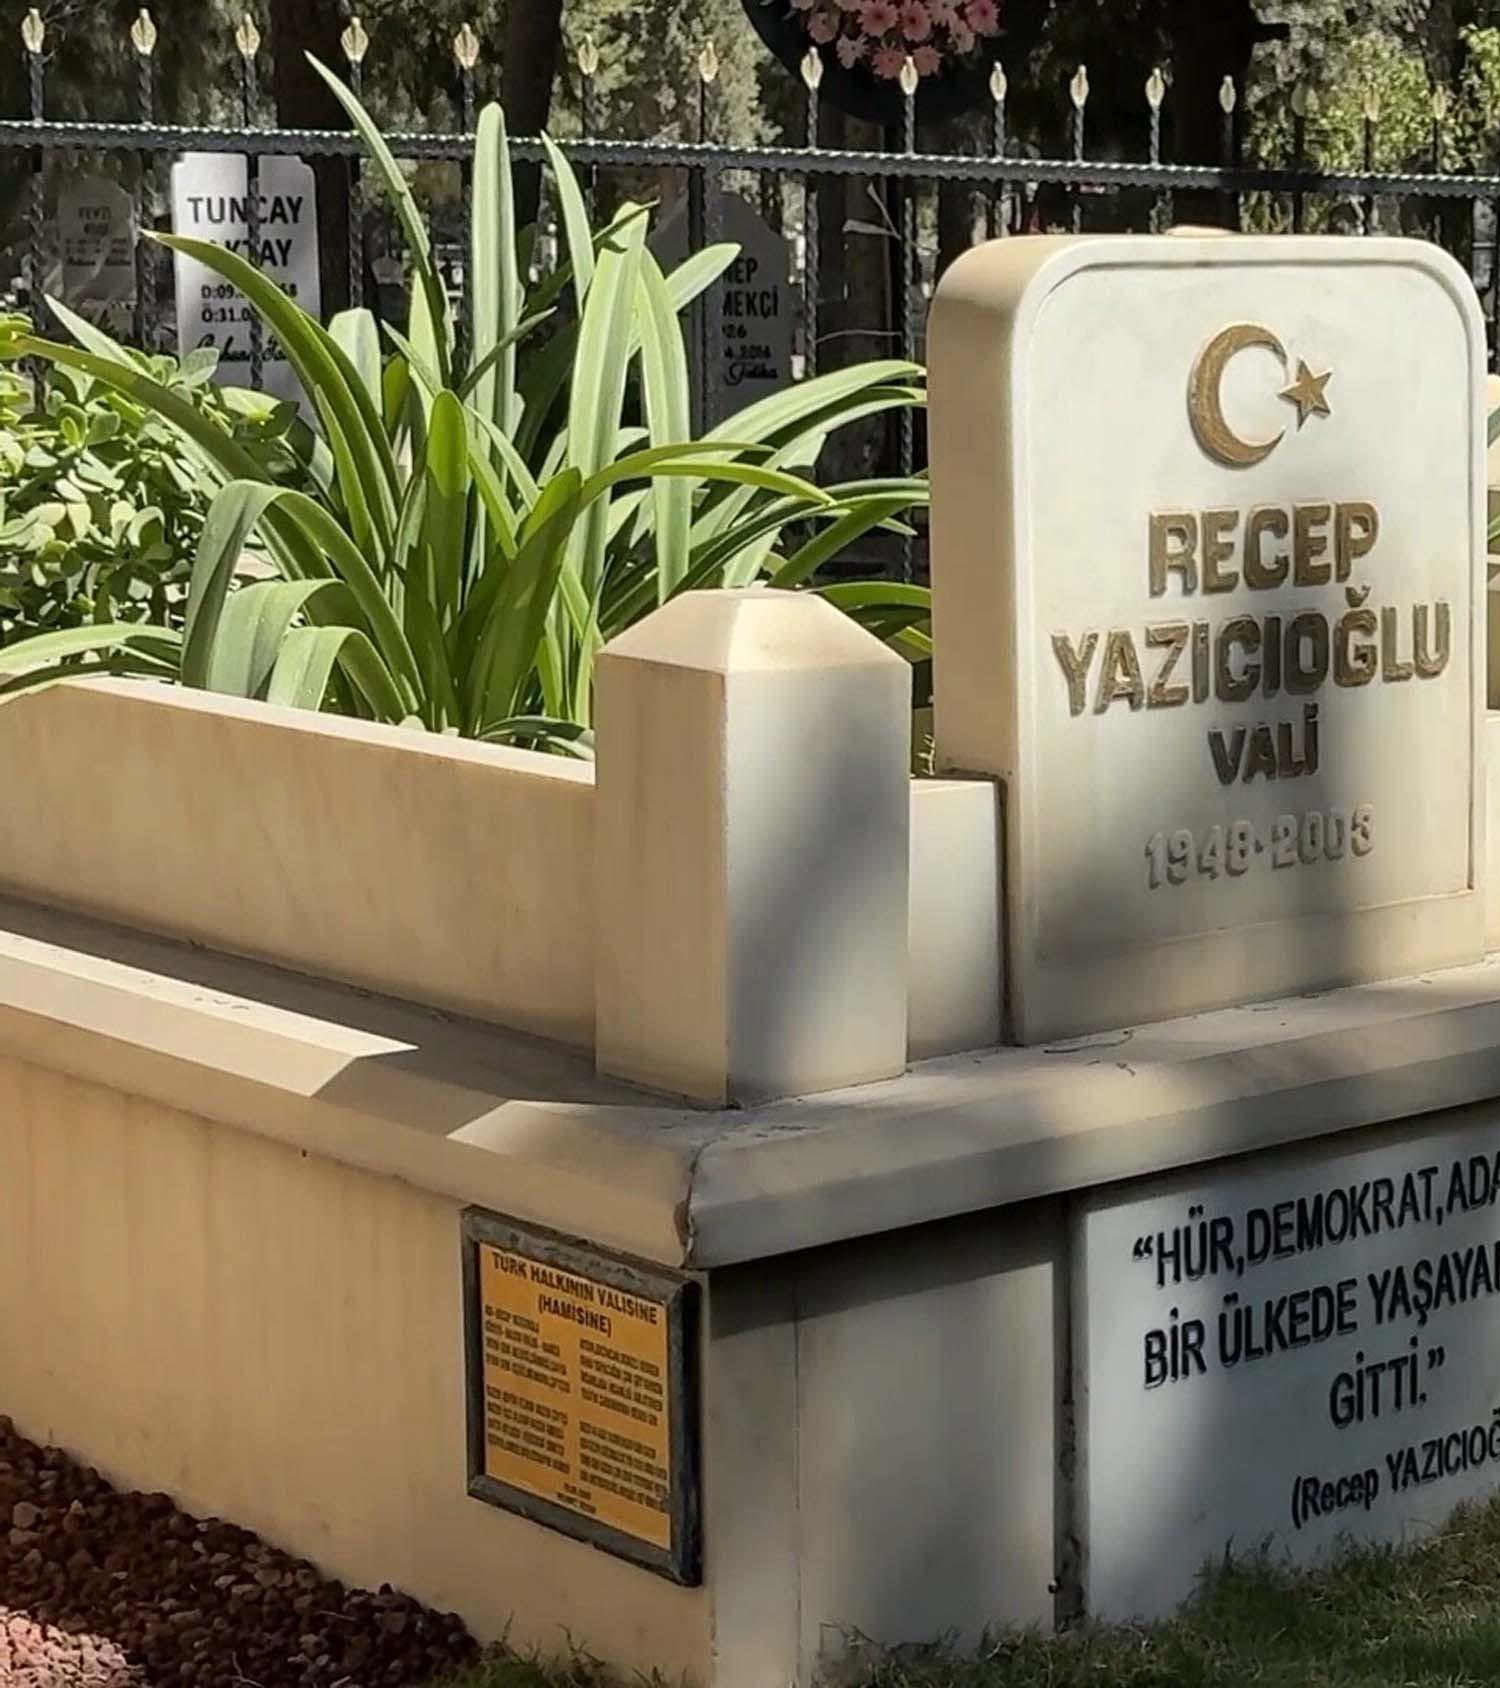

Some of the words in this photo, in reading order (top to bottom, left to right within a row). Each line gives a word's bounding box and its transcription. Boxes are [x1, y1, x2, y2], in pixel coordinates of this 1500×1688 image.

[1148, 500, 1380, 598] RECEP
[1050, 585, 1451, 717] YAZICIOĞLU
[1208, 703, 1320, 786] VALİ
[1145, 1307, 1207, 1389] BİR
[1218, 1291, 1358, 1368] ÜLKEDE
[1291, 1467, 1380, 1529] (Recep
